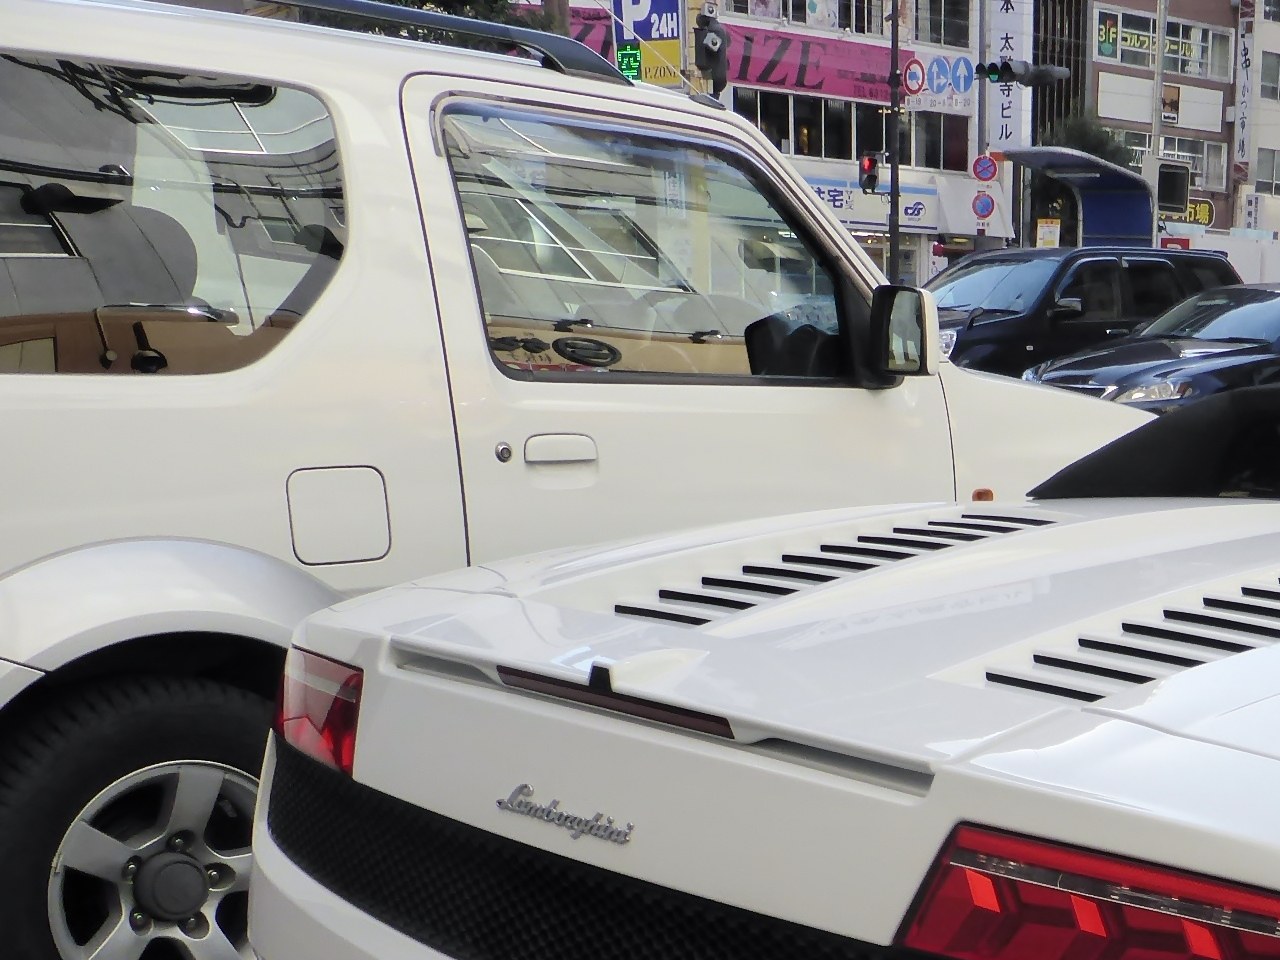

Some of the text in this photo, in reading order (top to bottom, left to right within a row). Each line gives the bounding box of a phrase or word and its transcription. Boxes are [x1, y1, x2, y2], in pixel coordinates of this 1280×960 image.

[622, 0, 650, 39] P
[651, 12, 677, 38] 24H
[1098, 25, 1116, 43] 3F
[726, 33, 827, 90] IZE
[496, 783, 635, 844] Lamborghini
